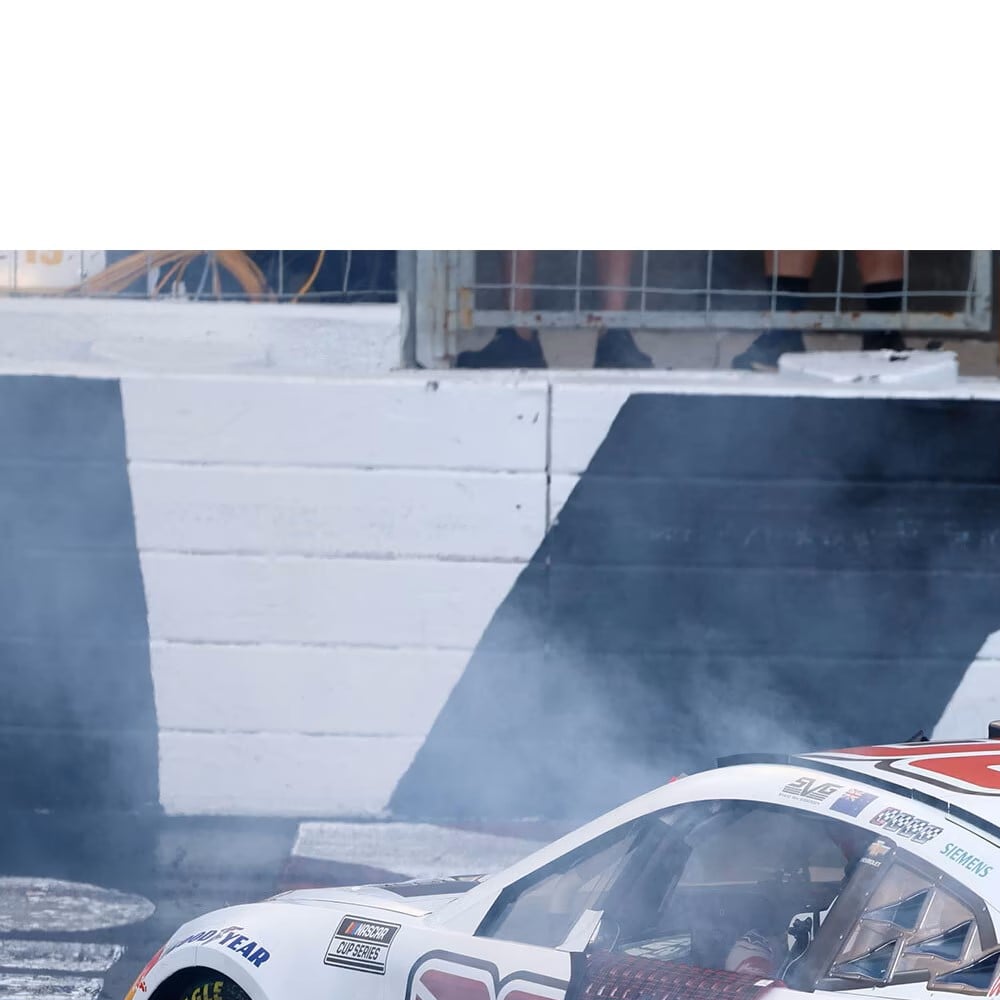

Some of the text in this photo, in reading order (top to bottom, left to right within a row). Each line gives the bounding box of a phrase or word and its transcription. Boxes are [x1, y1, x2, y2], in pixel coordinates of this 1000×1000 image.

[940, 842, 993, 878] SIEMENS
[354, 922, 389, 940] NASCAR
[337, 941, 380, 960] CUP SERIES
